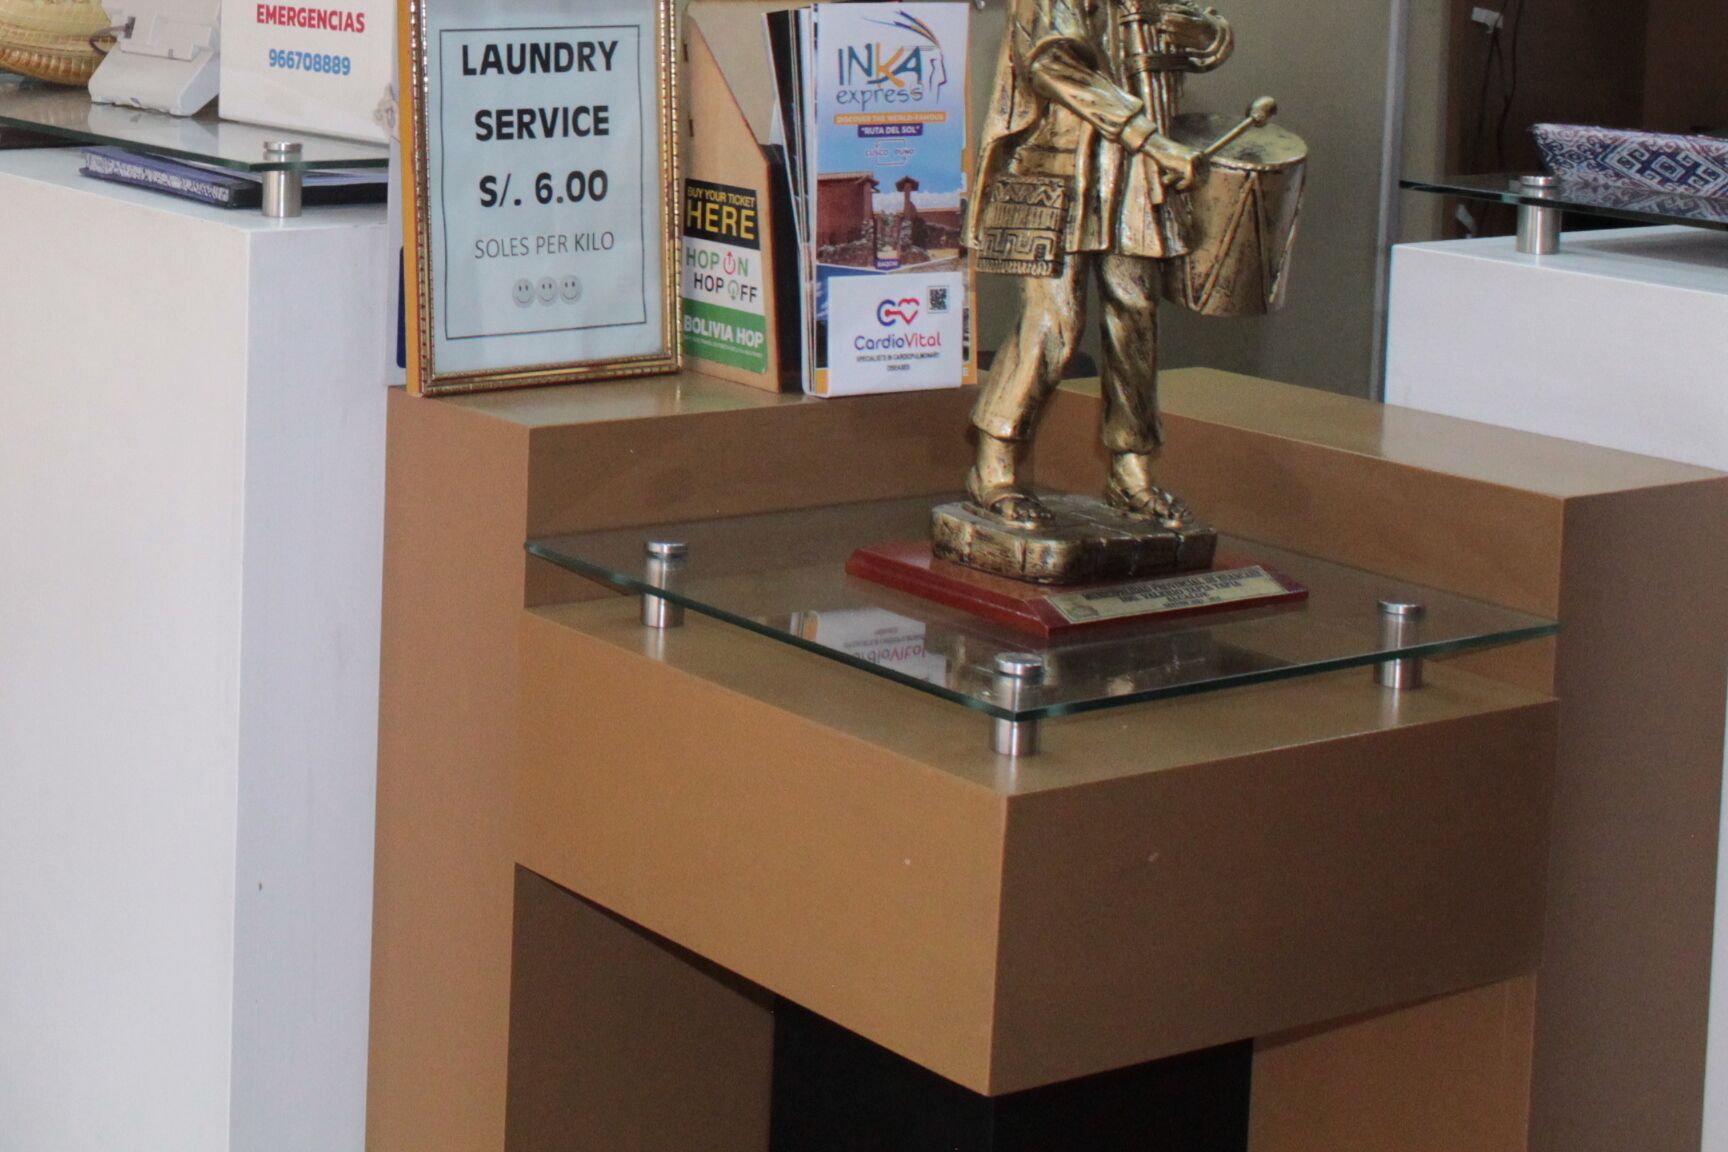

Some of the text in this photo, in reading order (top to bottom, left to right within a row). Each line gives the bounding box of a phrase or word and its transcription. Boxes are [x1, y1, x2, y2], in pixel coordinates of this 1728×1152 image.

[256, 3, 365, 34] EMERGENCIAS
[269, 48, 351, 76] 966708889
[461, 40, 618, 76] LAUNDRY
[837, 42, 923, 88] INKA
[836, 86, 924, 112] express
[475, 105, 609, 142] SERVICE
[886, 126, 900, 134] DEL
[479, 169, 608, 208] S/. 6.00
[687, 187, 756, 208] BUY YOUR TICKET
[687, 199, 756, 240] HERE
[474, 231, 615, 260] SOLES PER KILO
[686, 246, 748, 277] HOP ON
[694, 272, 757, 302] HOP OFF
[684, 314, 733, 342] BOLIVIA
[736, 327, 764, 348] HOP
[854, 331, 941, 351] CardioVital
